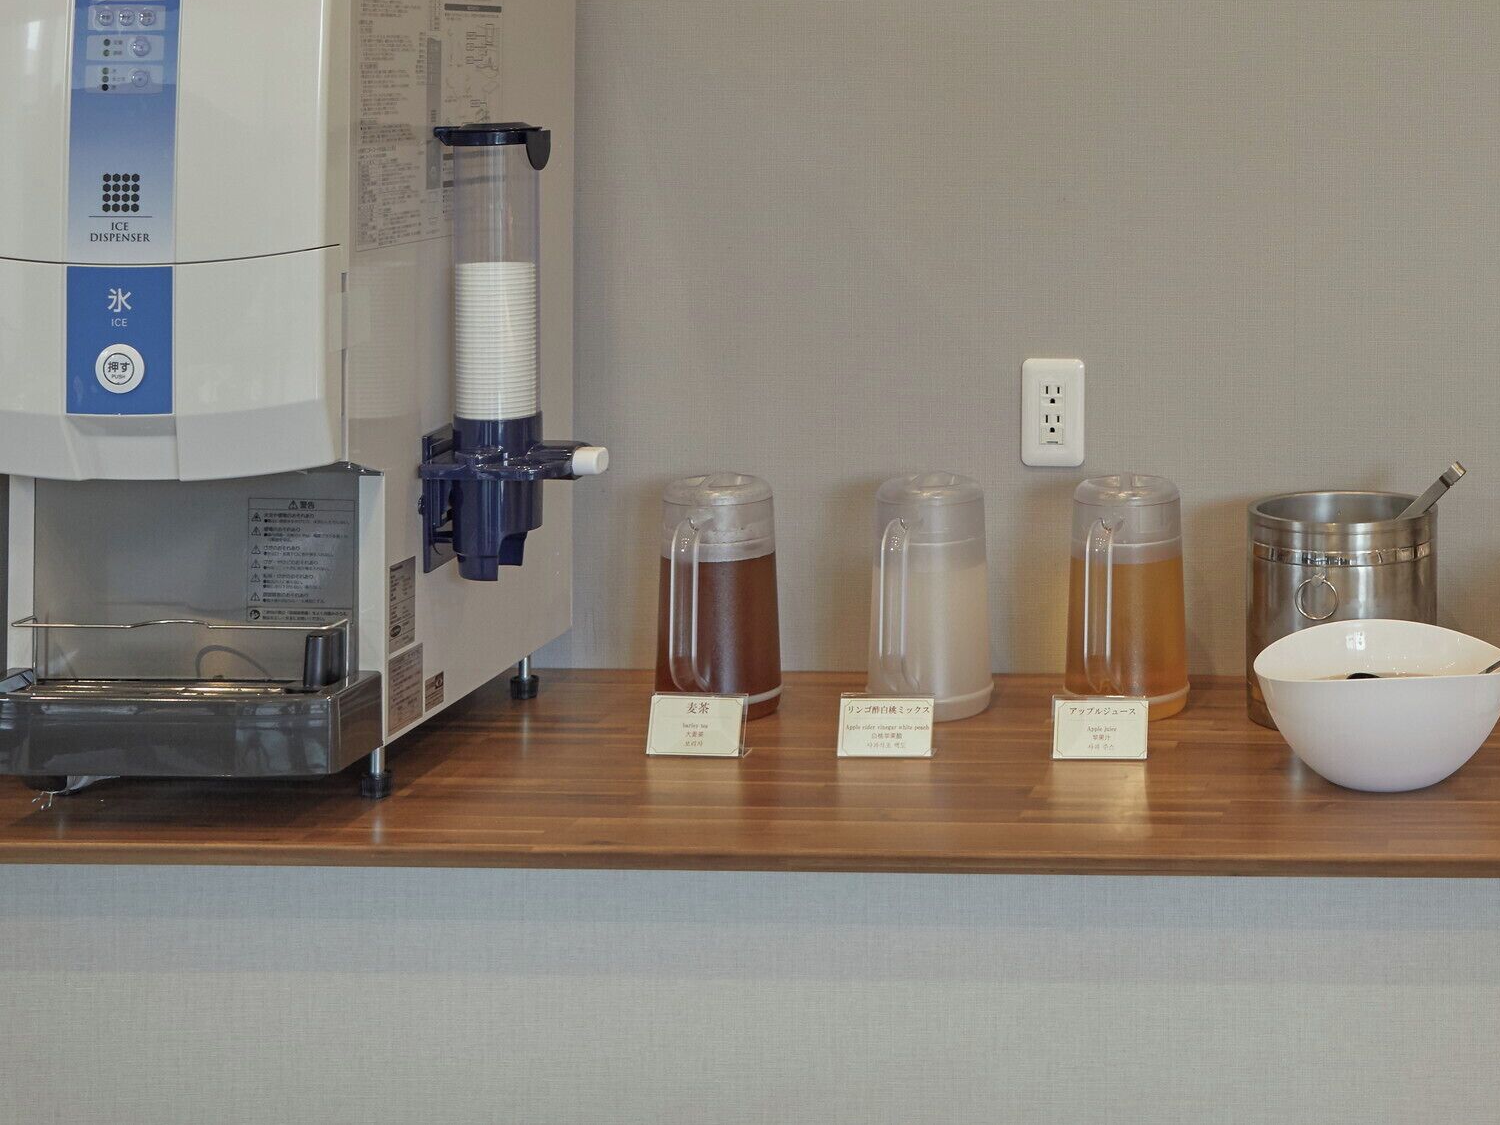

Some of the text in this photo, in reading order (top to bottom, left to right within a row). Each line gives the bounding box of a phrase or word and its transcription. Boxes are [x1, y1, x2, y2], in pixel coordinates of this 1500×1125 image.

[111, 222, 129, 231] ICE
[90, 233, 151, 242] DISPENSER
[107, 287, 132, 313] 氷
[111, 318, 128, 327] ICE
[107, 360, 130, 373] 押す
[687, 701, 710, 714] 麦茶
[848, 705, 930, 714] リンゴ酢白桃ミックス
[1069, 707, 1136, 715] アップルジュース
[1087, 725, 1103, 733] Apple
